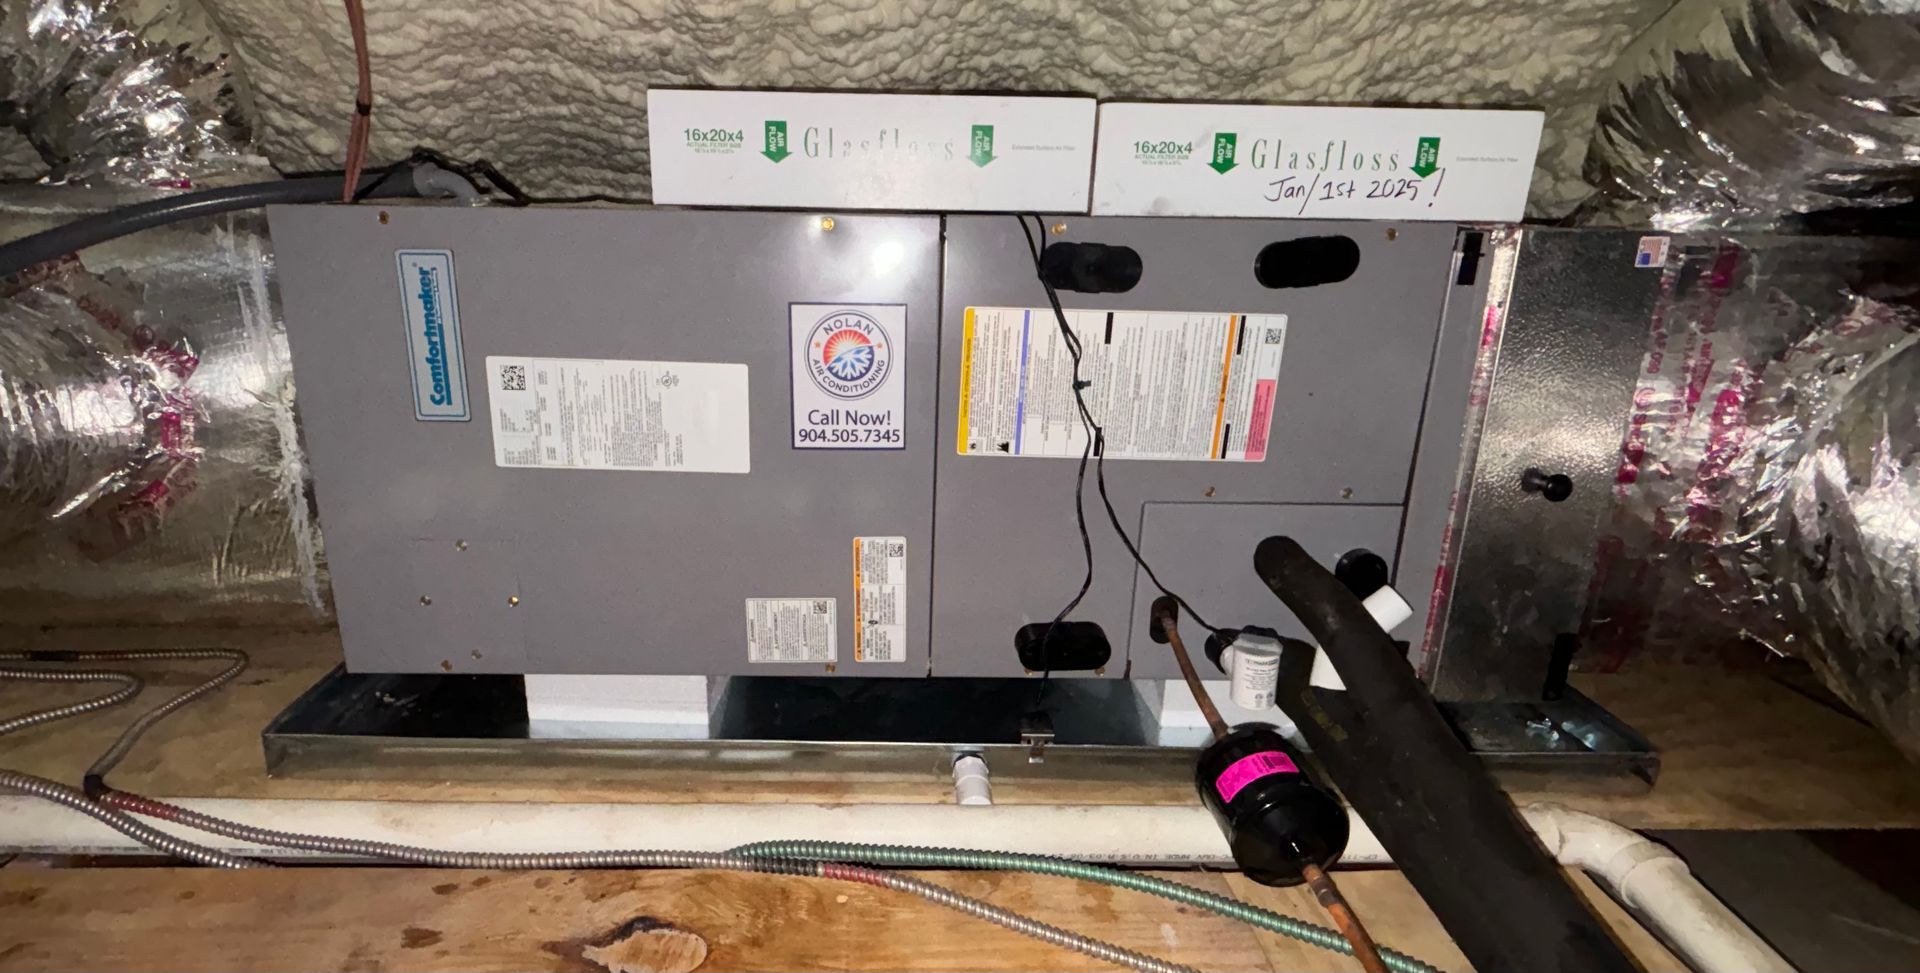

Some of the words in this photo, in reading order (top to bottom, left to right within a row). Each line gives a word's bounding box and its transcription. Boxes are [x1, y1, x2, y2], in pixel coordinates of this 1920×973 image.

[684, 128, 744, 142] 16x20x4
[769, 126, 777, 152] FLOW
[776, 131, 785, 147] AIR
[975, 130, 983, 157] FLOW
[982, 135, 991, 152] AIR
[1133, 140, 1193, 154] 16x20x4
[1216, 138, 1226, 163] FLOW
[1225, 143, 1233, 159] AIR
[1251, 138, 1398, 171] Glasfloss
[1419, 142, 1430, 168] FLOW
[1427, 147, 1436, 163] AIR
[823, 318, 874, 335] NOLAN
[418, 266, 445, 406] Comfortmaker
[813, 359, 824, 376] AIR
[822, 359, 885, 393] CONDITIONING
[808, 409, 839, 426] Call
[845, 409, 891, 426] Now!
[799, 428, 900, 443] 904.505.7345
